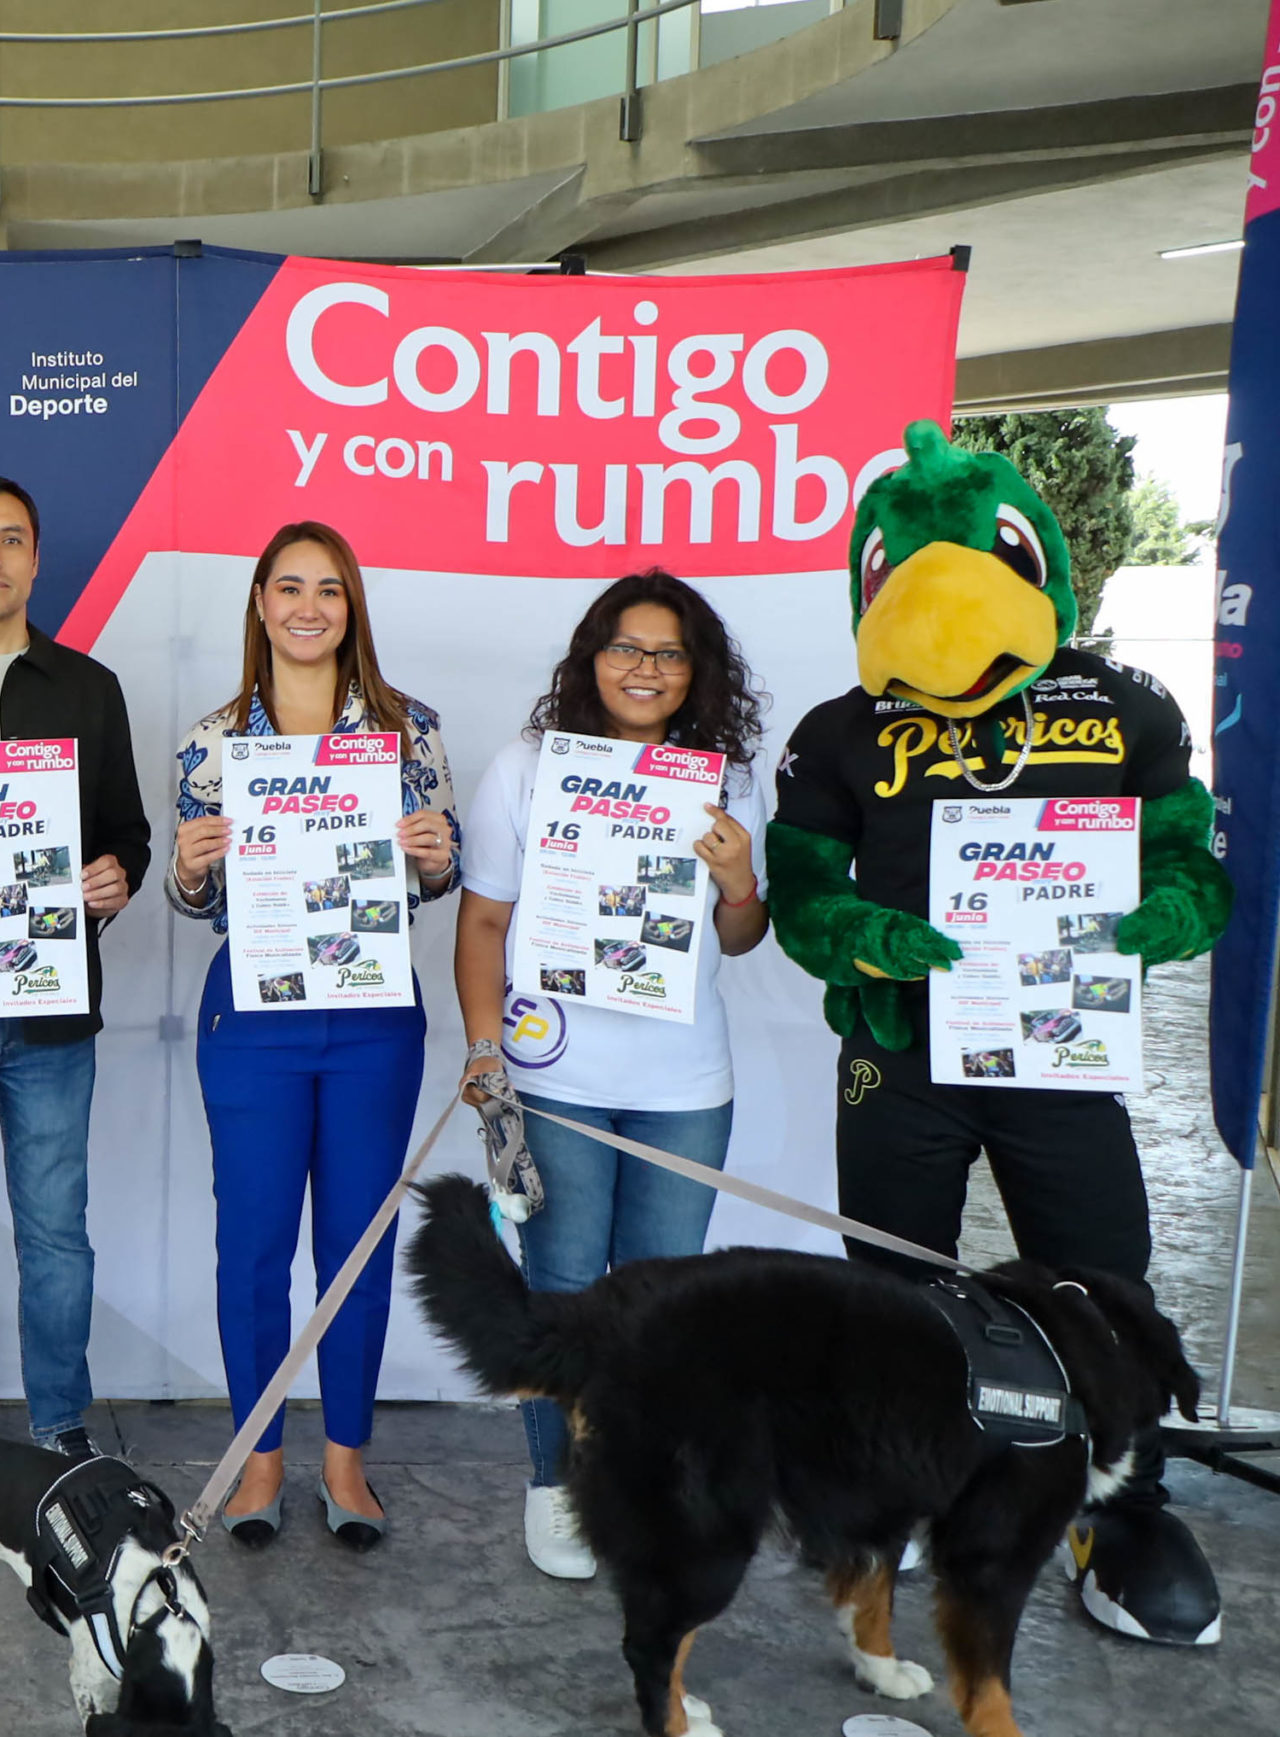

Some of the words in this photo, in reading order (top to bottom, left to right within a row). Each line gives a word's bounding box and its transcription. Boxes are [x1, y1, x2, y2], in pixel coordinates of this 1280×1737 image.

[31, 351, 104, 367] Instituto
[286, 282, 829, 455] Contigo
[22, 373, 106, 392] Municipal
[111, 371, 137, 387] del
[10, 394, 108, 420] Deporte
[286, 429, 328, 488] y
[343, 435, 453, 481] con
[1072, 691, 1114, 704] Cola
[5, 743, 61, 758] Contigo
[329, 736, 384, 752] Contigo
[27, 756, 73, 770] rumbo
[349, 749, 395, 763] rumbo
[651, 748, 708, 767] Contigo
[669, 765, 717, 783] rumbo
[248, 776, 331, 796] GRAN
[560, 775, 647, 802] GRAN
[262, 794, 358, 815] PASEO
[570, 795, 670, 824] PASEO
[1054, 800, 1119, 816] Contigo
[305, 813, 367, 832] PADRE
[546, 820, 581, 840] 16
[1077, 813, 1133, 829] rumbo
[242, 826, 276, 843] 16
[611, 824, 676, 842] PADRE
[244, 845, 272, 855] junio
[545, 839, 574, 851] junio
[959, 842, 1055, 861] GRAN
[973, 862, 1086, 881] PASEO
[950, 892, 988, 911] 16
[1023, 883, 1095, 901] PADRE
[951, 913, 983, 922] junio
[12, 972, 60, 995] Pericos
[336, 967, 384, 988] Pericos
[1024, 1393, 1061, 1422] SUPPORT
